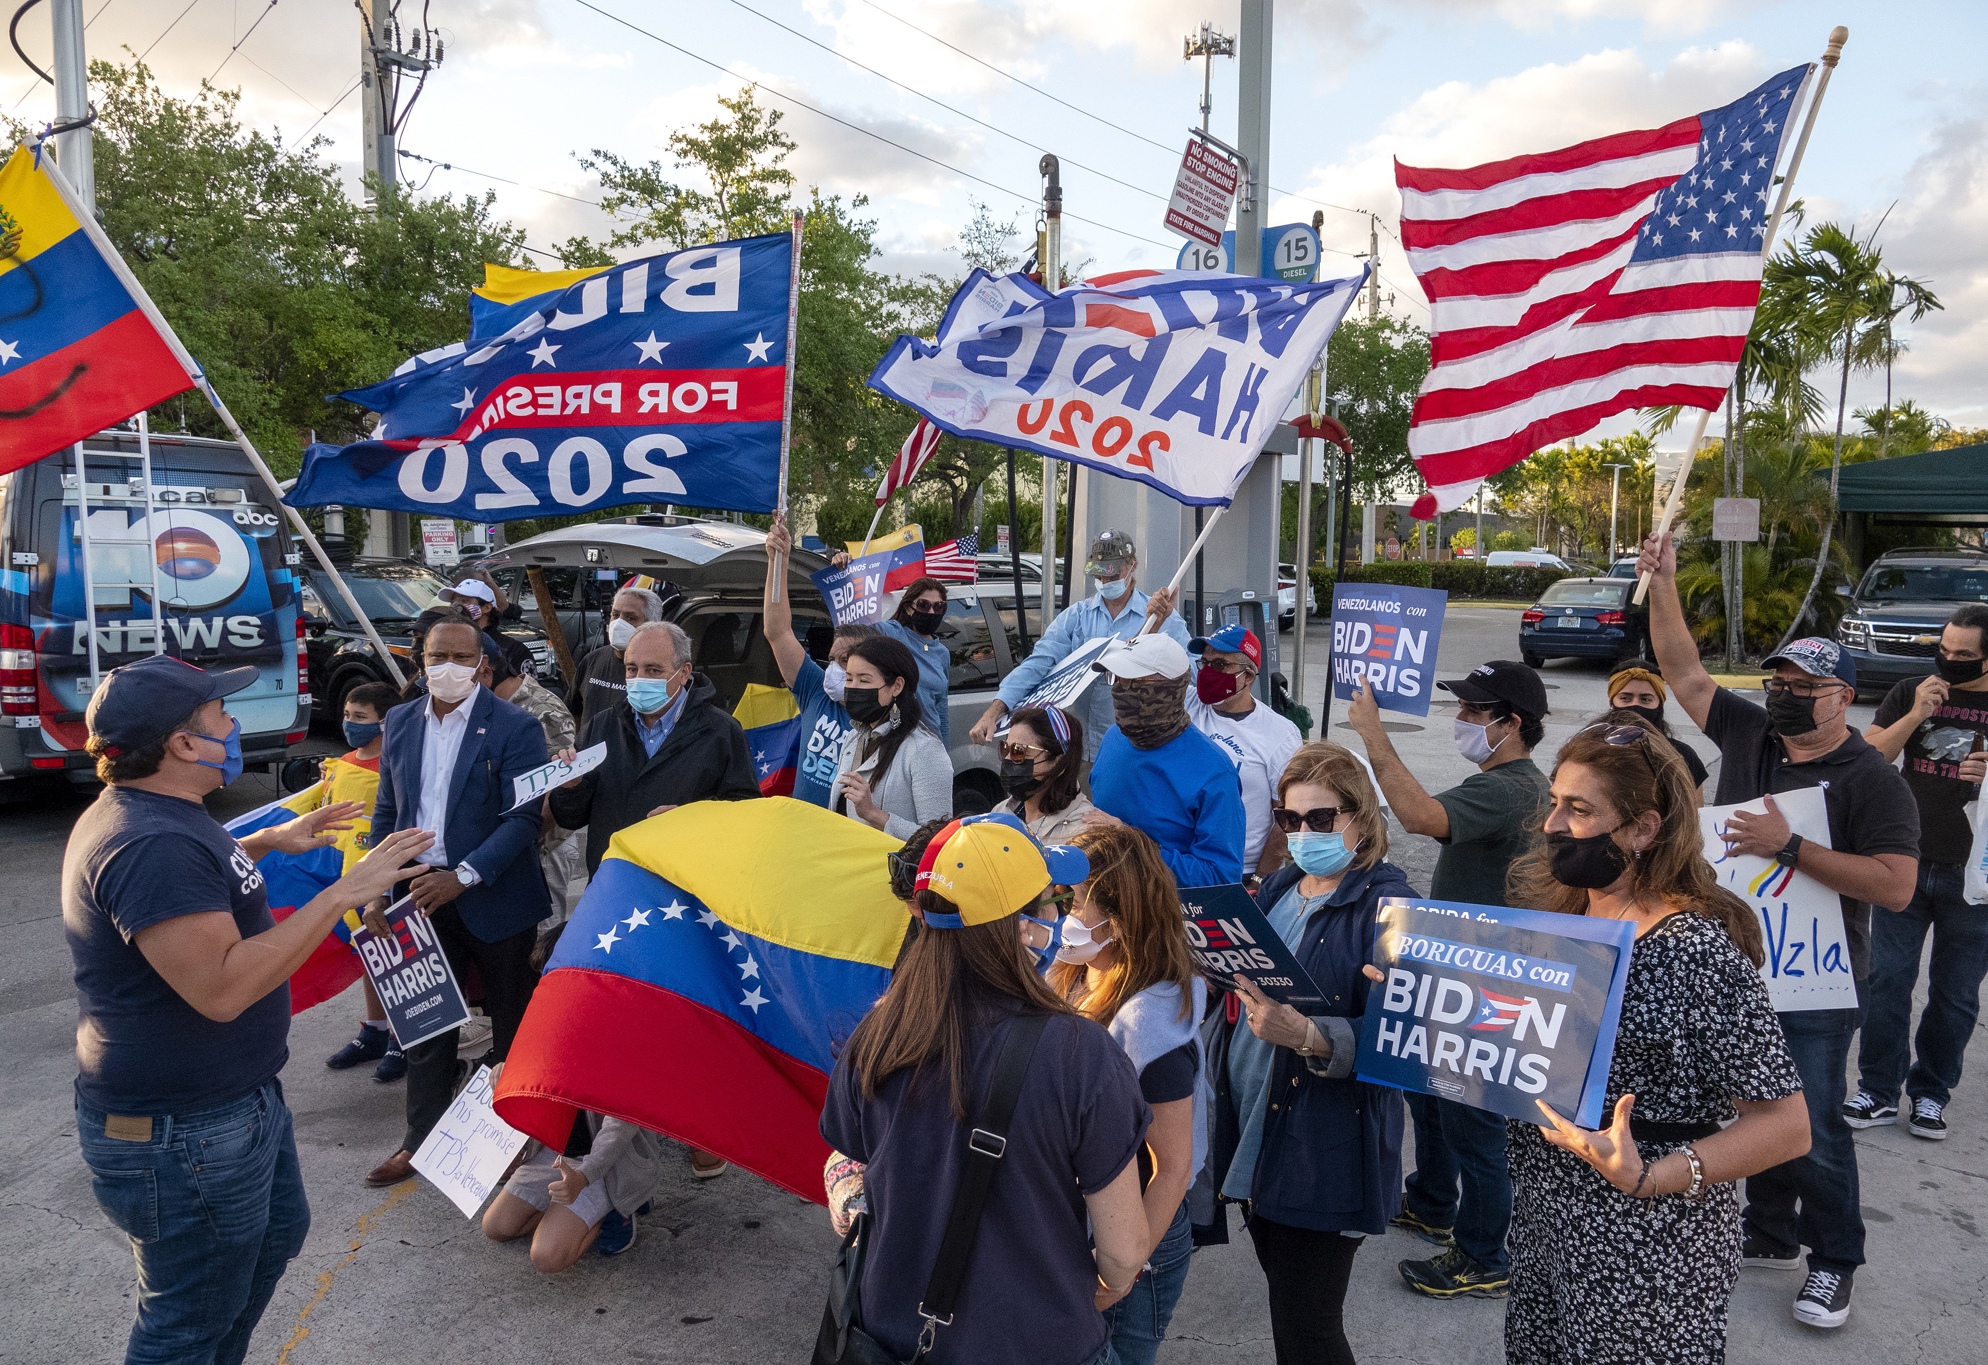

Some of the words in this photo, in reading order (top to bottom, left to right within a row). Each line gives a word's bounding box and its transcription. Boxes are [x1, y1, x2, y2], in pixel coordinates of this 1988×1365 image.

[1186, 156, 1206, 174] STOP
[1206, 168, 1234, 190] ENGINE
[1191, 144, 1202, 158] NO
[1203, 149, 1236, 178] SMOKING
[1176, 190, 1204, 208] UNAUTHORIZED
[1203, 202, 1225, 220] CONTAINERS
[1177, 180, 1195, 194] GASOLINE
[1195, 189, 1204, 199] INTO
[1211, 197, 1223, 209] GLASS
[1223, 204, 1229, 212] OR
[1204, 184, 1210, 192] TO
[1209, 187, 1227, 202] DISPENSE
[1169, 213, 1182, 225] STATE
[1183, 218, 1194, 230] FIRE
[1193, 223, 1217, 242] MARSHALL
[1192, 208, 1204, 219] ORDER
[1192, 248, 1219, 270] 16
[1284, 236, 1308, 263] 15
[1283, 269, 1307, 279] DIESEL
[233, 508, 279, 526] abc
[73, 508, 250, 607] 10
[829, 573, 880, 610] BIDEN
[1338, 598, 1401, 614] VENEZOLANOS
[1406, 606, 1427, 616] con
[836, 596, 878, 626] HARRIS
[72, 615, 266, 655] NEWS
[1334, 621, 1428, 664] BIDEN
[275, 679, 283, 690] 70
[589, 678, 610, 688] SWISS
[1334, 658, 1420, 697] HARRIS
[815, 714, 850, 744] MIA
[808, 730, 838, 763] DA
[521, 760, 573, 792] TPS
[1189, 902, 1202, 917] for
[362, 910, 433, 977] BIDEN
[1762, 902, 1849, 979] Vzla
[1397, 935, 1527, 979] BORICUAS
[1529, 966, 1570, 987] con
[378, 952, 447, 1009] HARRIS
[1257, 977, 1293, 986] 30330
[405, 993, 444, 1020] JOEBIDEN.COM
[1383, 968, 1567, 1049] BIDEN
[1376, 1017, 1552, 1094] HARRIS
[450, 1094, 474, 1123] his
[425, 1129, 468, 1176] TPS
[464, 1118, 516, 1155] promise
